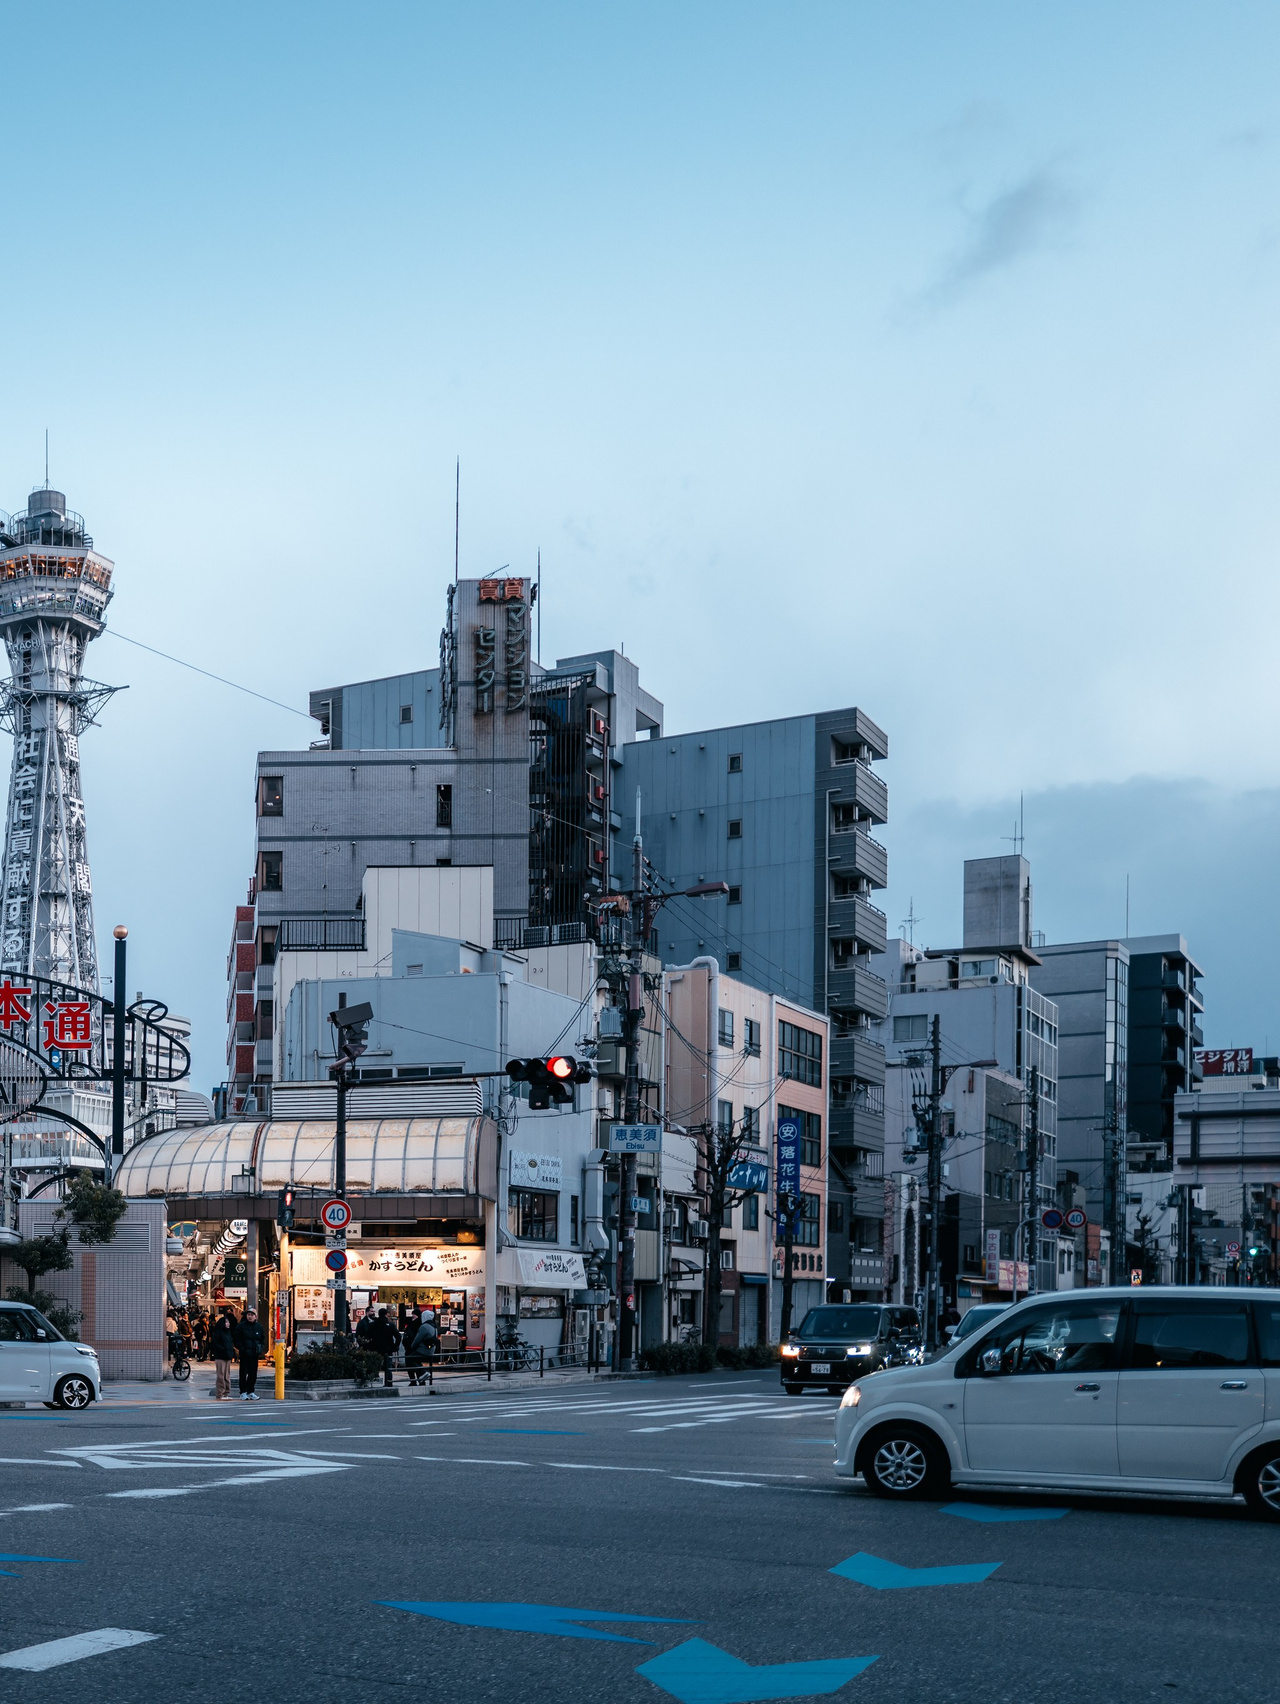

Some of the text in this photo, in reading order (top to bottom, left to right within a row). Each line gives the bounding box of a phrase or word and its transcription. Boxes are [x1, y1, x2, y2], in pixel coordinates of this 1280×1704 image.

[505, 603, 526, 711] マンション
[474, 626, 495, 712] センター
[63, 732, 92, 894] 通天閣
[615, 1128, 657, 1142] 恵美須
[626, 1142, 645, 1150] Ebisu
[328, 1208, 345, 1221] 40
[1070, 1214, 1082, 1224] 40
[326, 1240, 346, 1248] ここから
[369, 1260, 434, 1273] かすうどん
[543, 1261, 569, 1273] かすうどん
